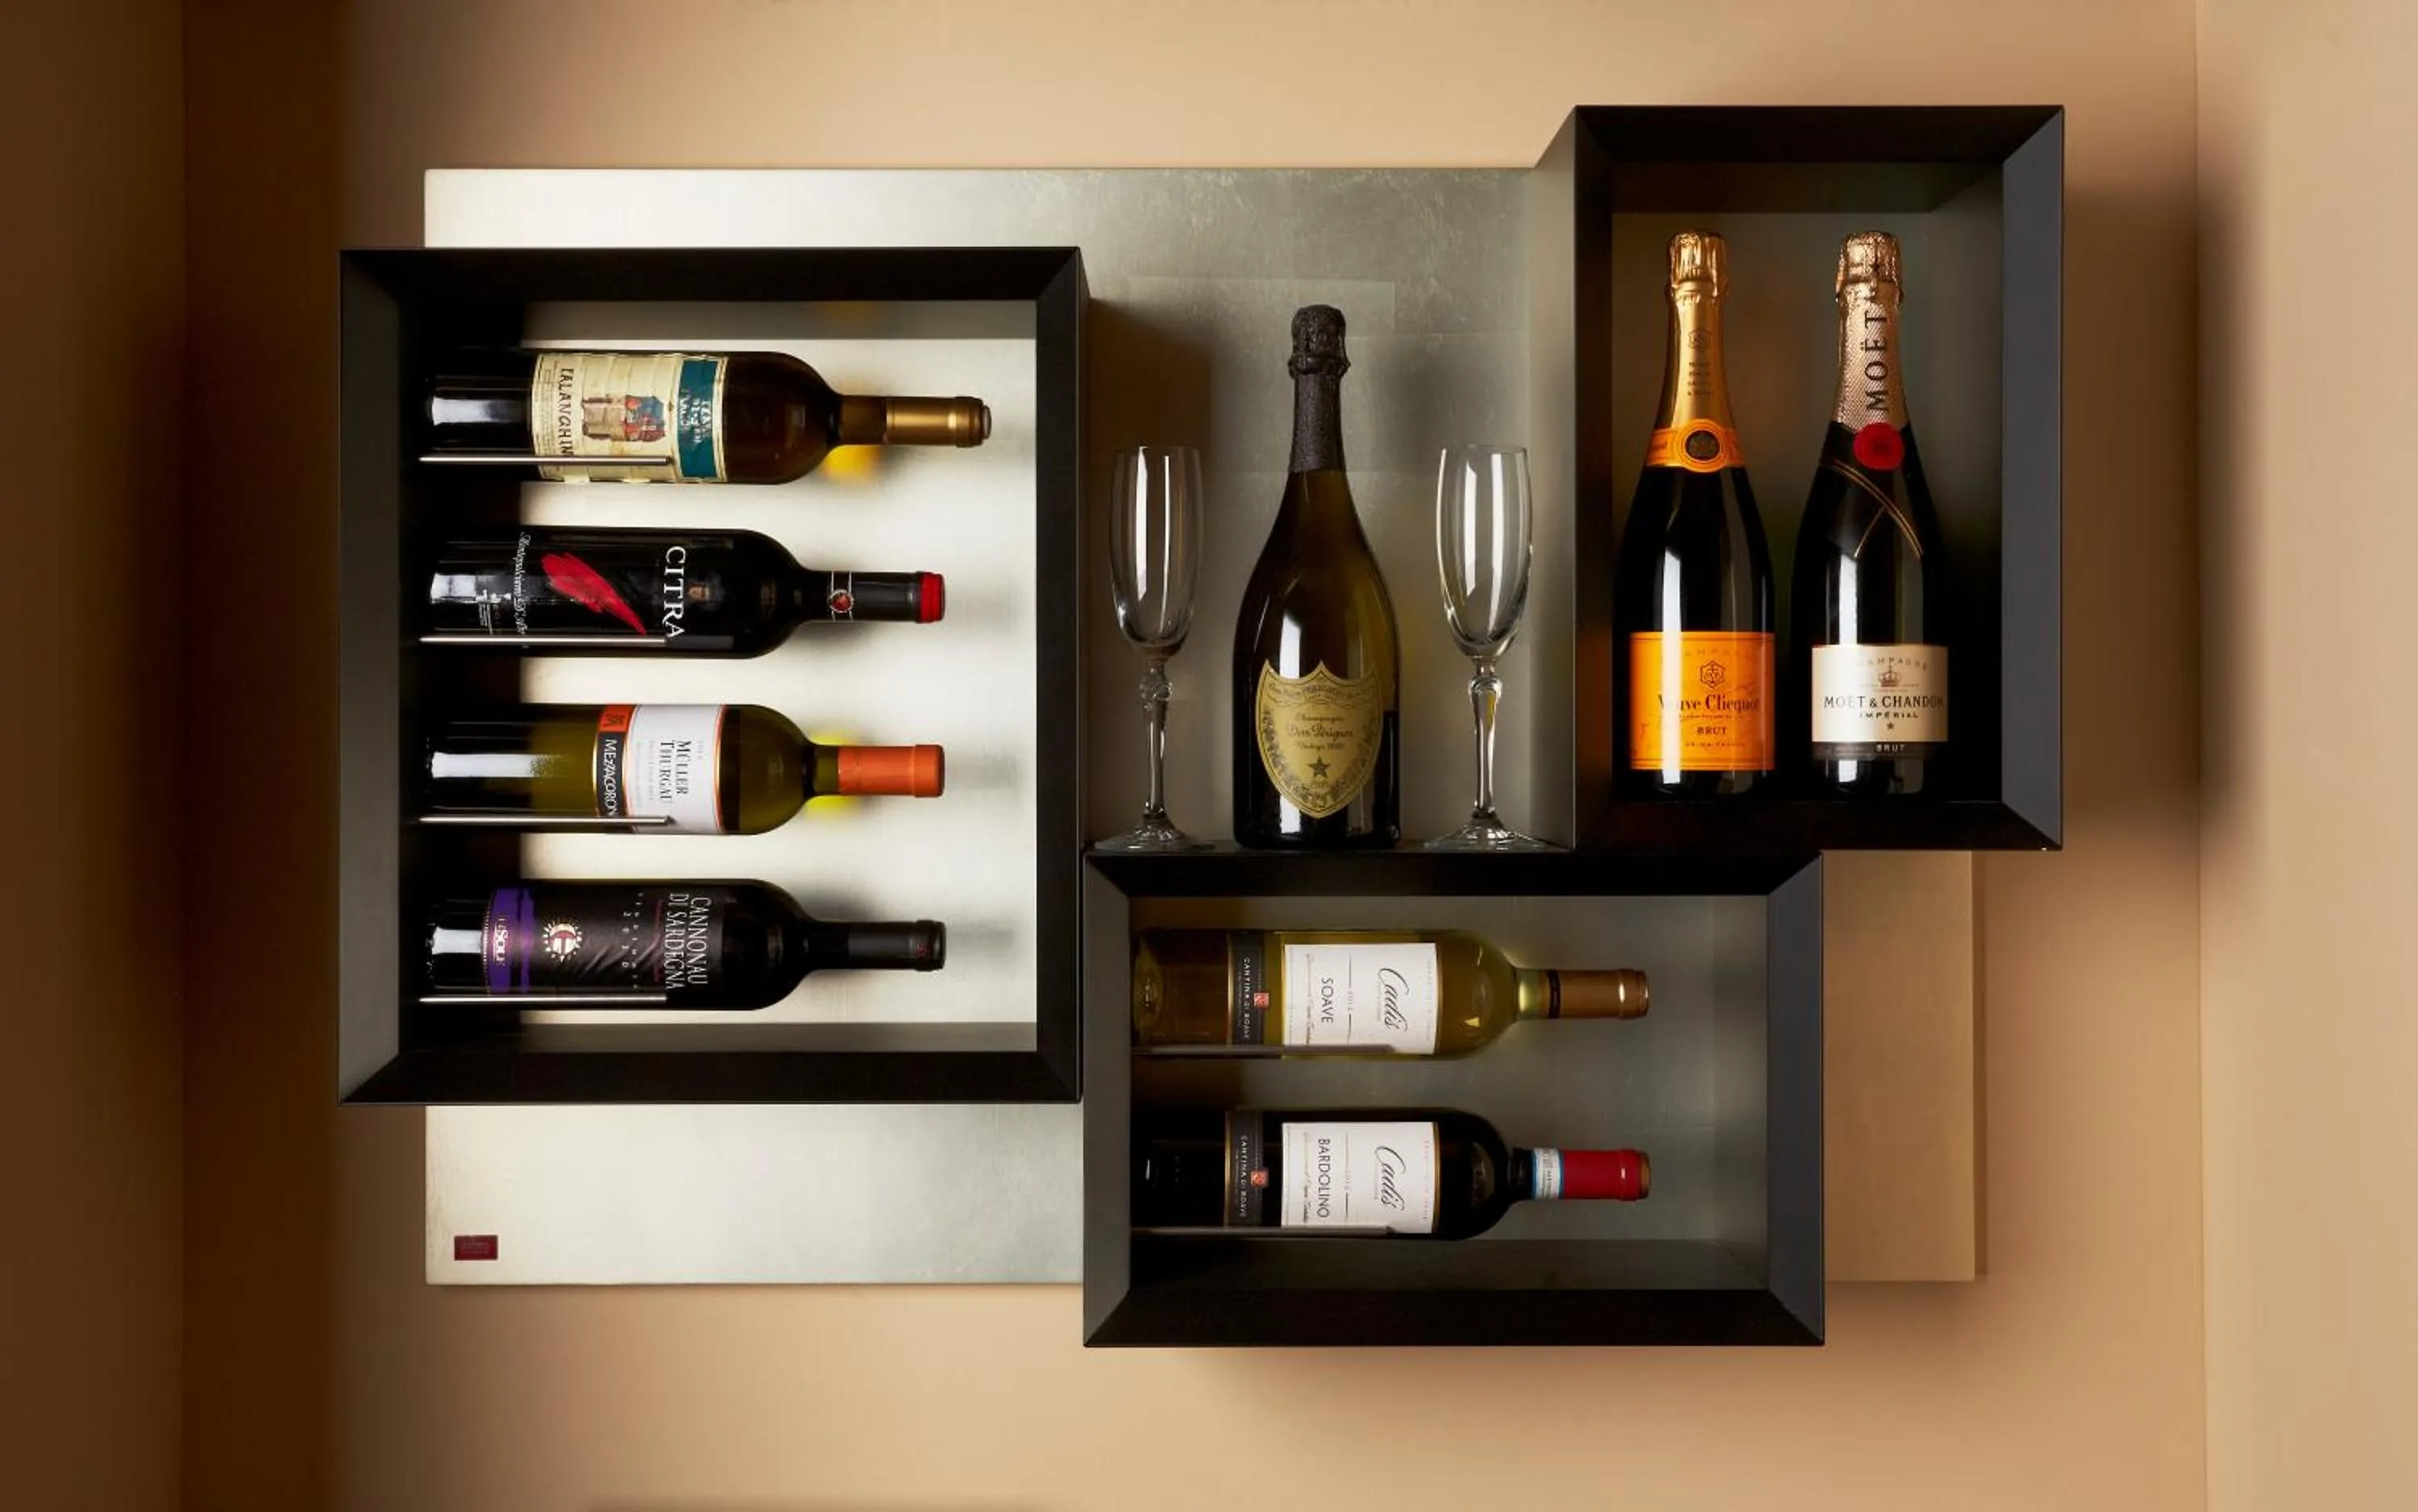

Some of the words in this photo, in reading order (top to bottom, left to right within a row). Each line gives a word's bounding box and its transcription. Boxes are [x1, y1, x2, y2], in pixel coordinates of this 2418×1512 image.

[1860, 310, 1888, 413] MOËT
[556, 368, 575, 457] FALANGHIN
[663, 546, 686, 638] CITRA
[1697, 726, 1727, 735] BRUT
[1869, 697, 1878, 708] &
[1881, 696, 1944, 708] CHANDON
[604, 739, 617, 816] MEZZACORON
[659, 740, 675, 804] THURGAU
[675, 741, 692, 794] MÜLLER
[1876, 744, 1905, 752] BRUT
[670, 893, 689, 907] DI
[664, 912, 687, 990] SARDEGNA
[686, 897, 712, 985] CANNONAU
[1321, 978, 1334, 1024] SOAVE
[1377, 968, 1410, 1032] Cadis
[1317, 1138, 1331, 1219] BARDOLINO
[1374, 1145, 1406, 1211] Cadis
